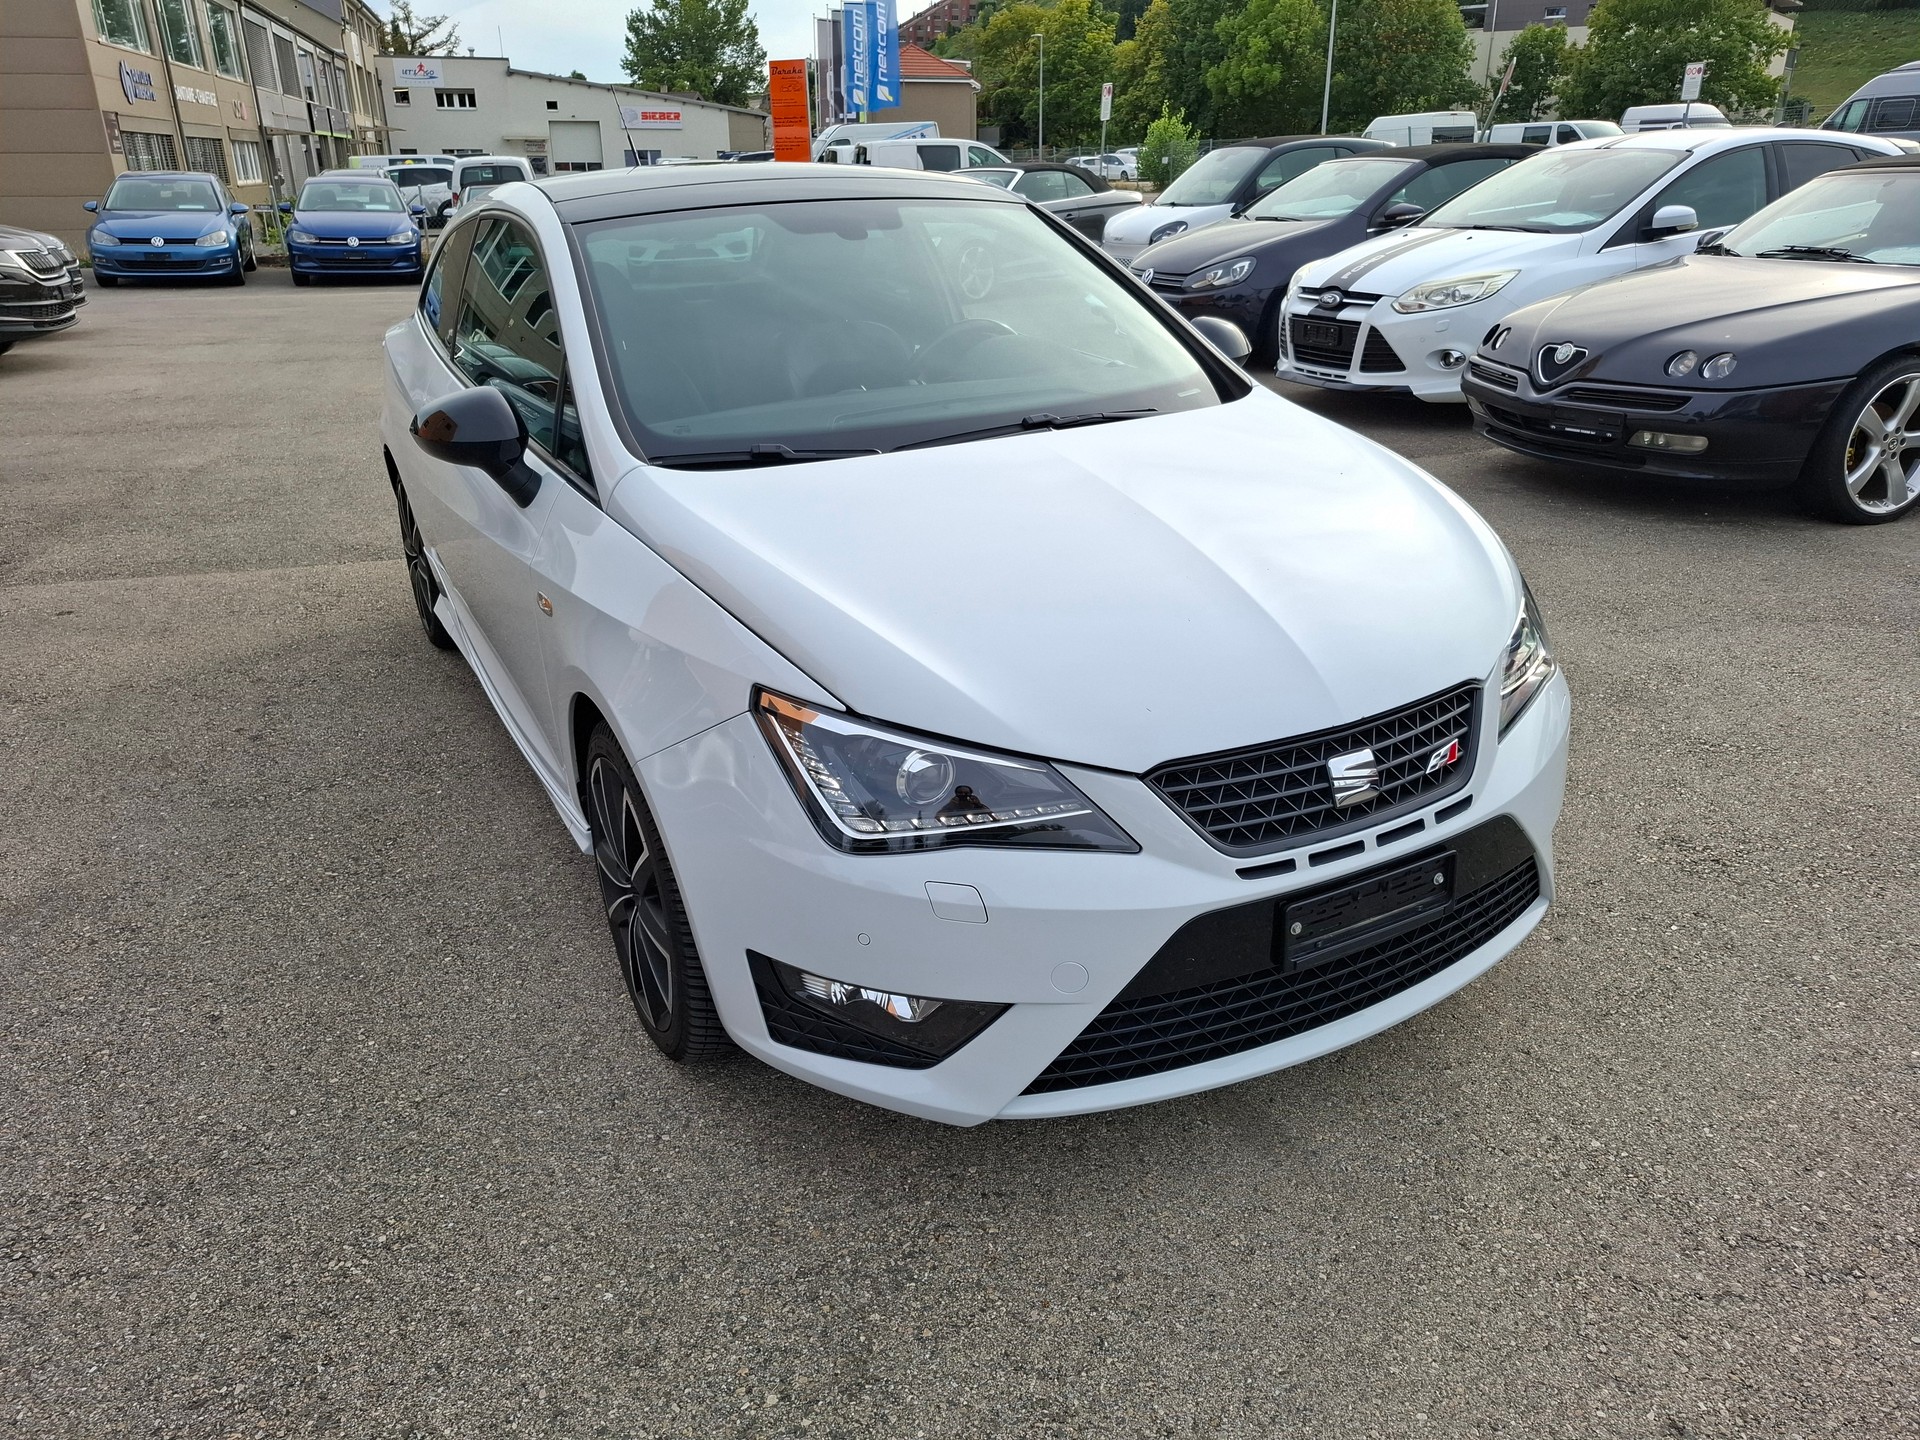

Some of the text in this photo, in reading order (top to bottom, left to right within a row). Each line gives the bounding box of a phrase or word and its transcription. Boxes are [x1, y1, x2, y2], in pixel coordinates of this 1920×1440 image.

[852, 9, 863, 86] netcom
[876, 1, 888, 81] netcom
[771, 66, 802, 75] Baraka
[641, 111, 681, 120] SIEBER
